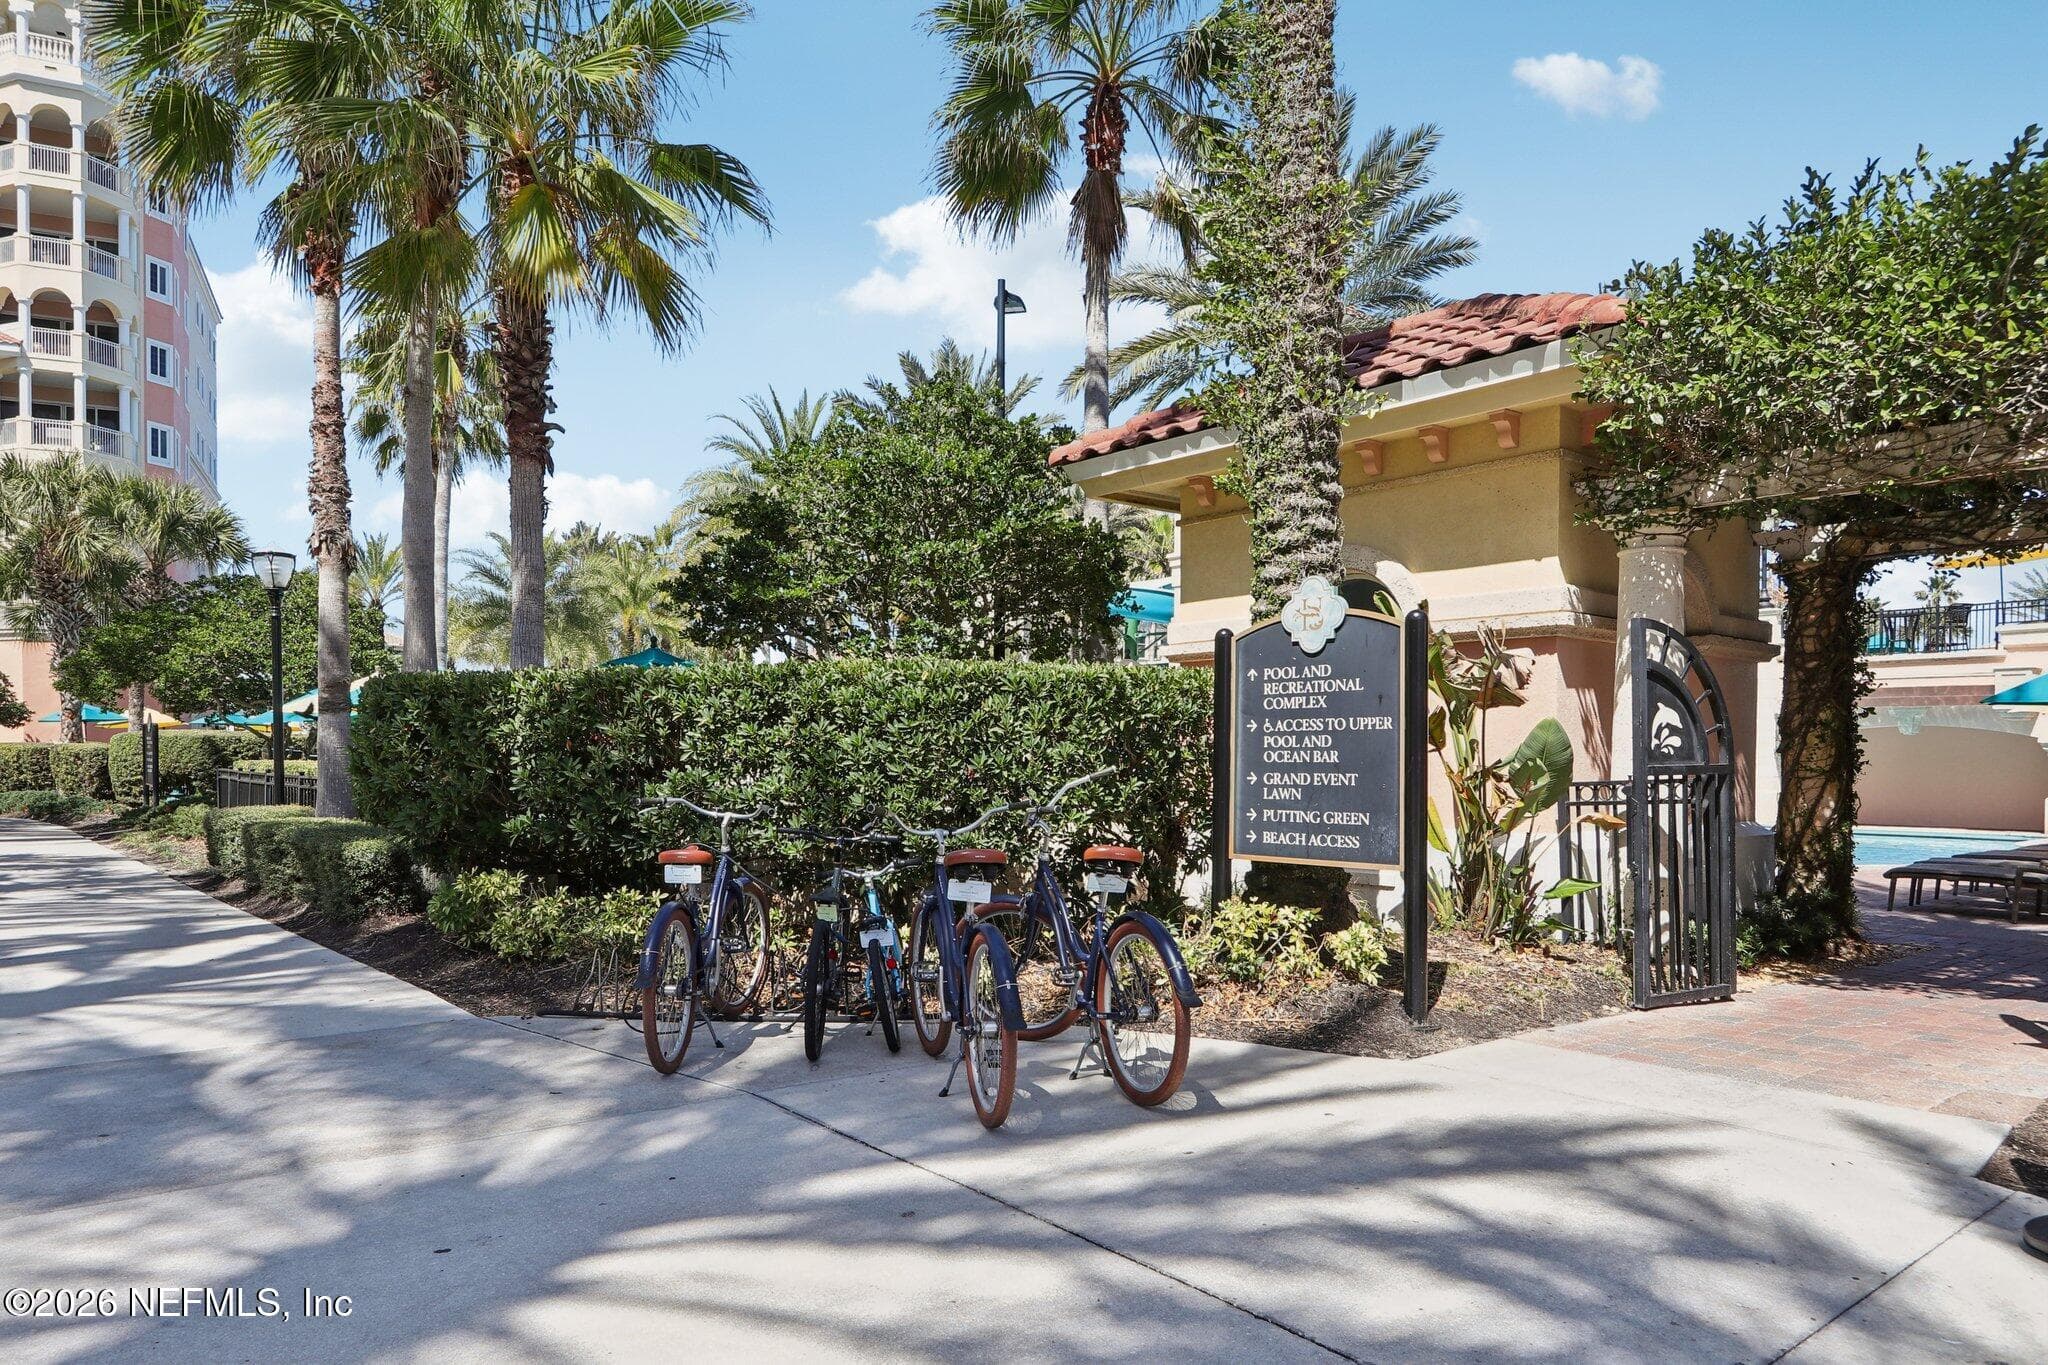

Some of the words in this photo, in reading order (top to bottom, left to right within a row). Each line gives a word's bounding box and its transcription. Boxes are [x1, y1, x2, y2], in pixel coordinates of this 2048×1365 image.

[1263, 667, 1300, 680] POOL
[1302, 664, 1332, 678] AND
[1263, 678, 1364, 695] RECREATIONAL
[1263, 695, 1327, 710] COMPLEX
[1275, 718, 1324, 732] ACCESS
[1325, 717, 1346, 731] TO
[1349, 716, 1393, 730] UPPER
[1263, 735, 1300, 748] POOL
[1302, 734, 1332, 747] AND
[1263, 751, 1313, 763] OCEAN
[1313, 750, 1340, 763] BAR
[1263, 772, 1311, 786] GRAND
[1313, 773, 1359, 786] EVENT
[1263, 787, 1302, 800] LAWN
[1262, 809, 1321, 824] PUTTING
[1323, 811, 1370, 826] GREEN
[1262, 831, 1306, 846] BEACH
[1308, 834, 1360, 849] ACCESS
